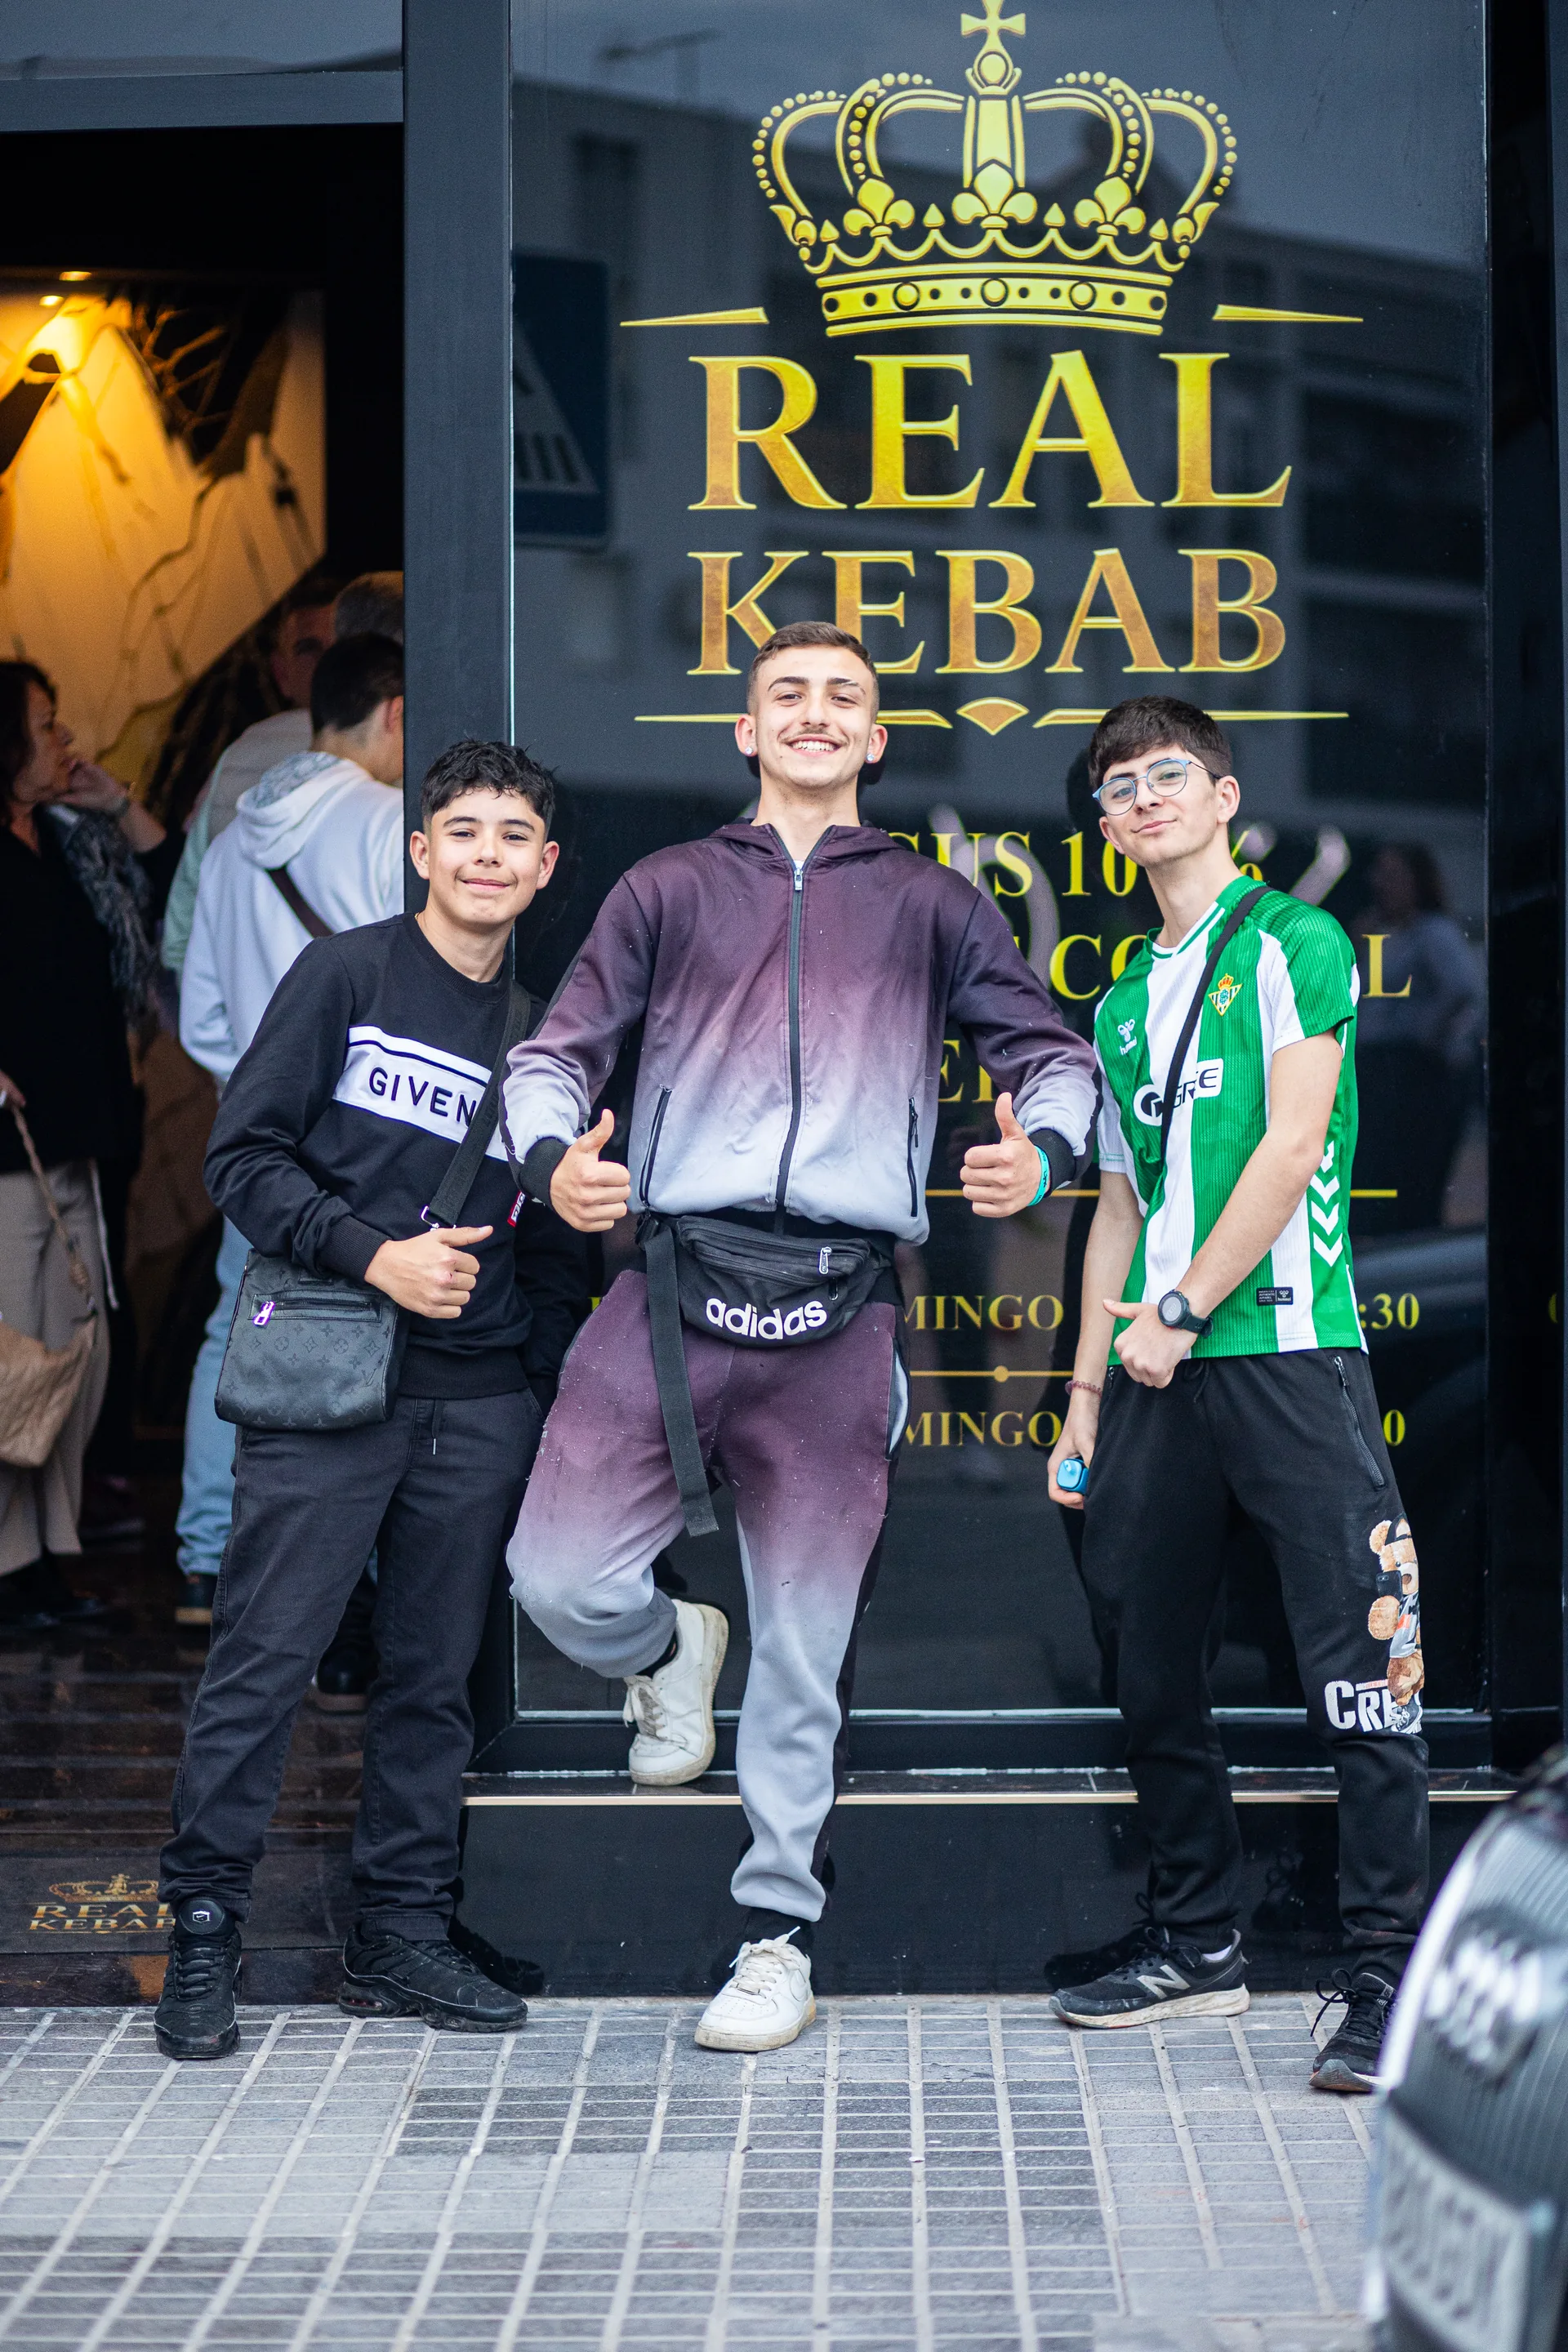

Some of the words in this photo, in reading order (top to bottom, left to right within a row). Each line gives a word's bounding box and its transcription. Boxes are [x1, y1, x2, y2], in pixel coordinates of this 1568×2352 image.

[688, 350, 1292, 510] REAL
[687, 548, 1286, 675] KEBAB
[706, 1298, 827, 1340] adidas
[33, 1903, 174, 1918] REAL
